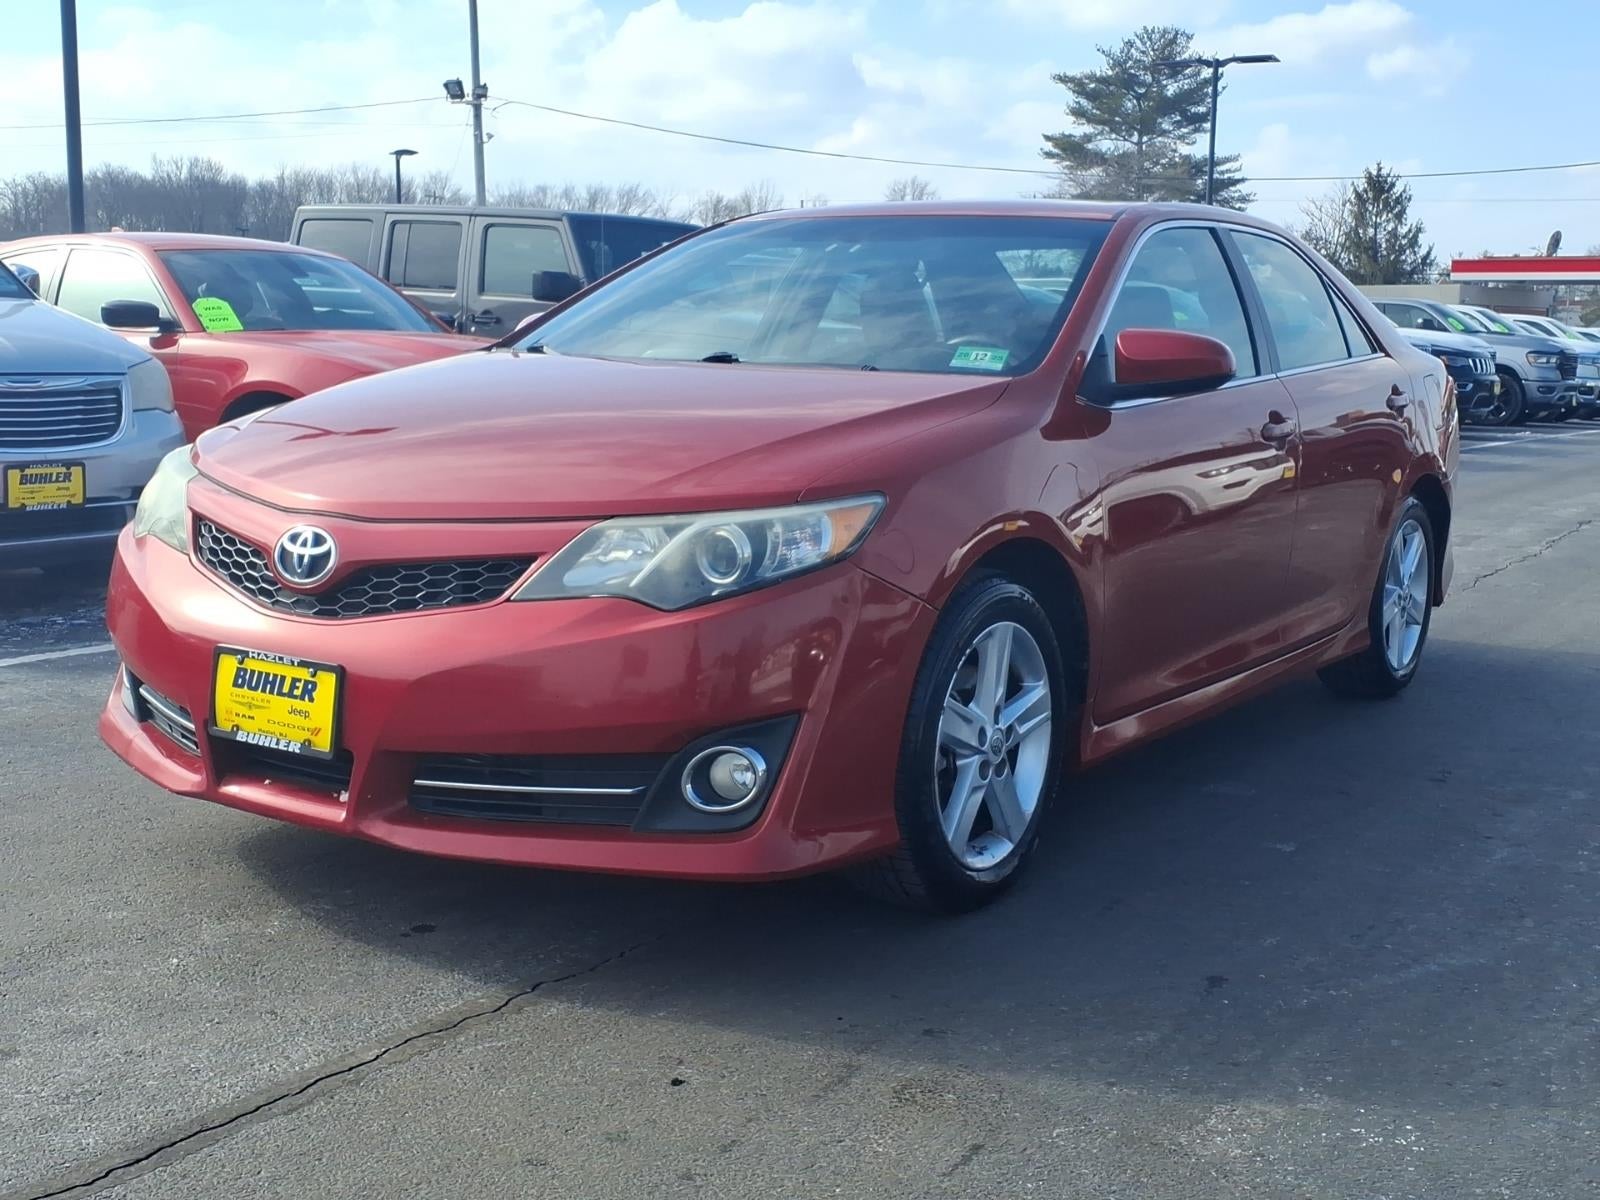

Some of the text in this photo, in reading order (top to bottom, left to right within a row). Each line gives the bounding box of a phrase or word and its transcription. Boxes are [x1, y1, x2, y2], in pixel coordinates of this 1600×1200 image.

[973, 352, 988, 361] 12
[19, 472, 72, 486] BUHLER
[26, 503, 67, 511] BUHLER
[248, 651, 300, 666] HAZLET
[232, 666, 318, 704] BUHLER
[229, 691, 271, 705] CHRYSLER
[234, 711, 255, 721] RAM
[287, 705, 310, 720] Jeep
[267, 719, 313, 733] DODGE
[236, 729, 301, 754] BUHLER
